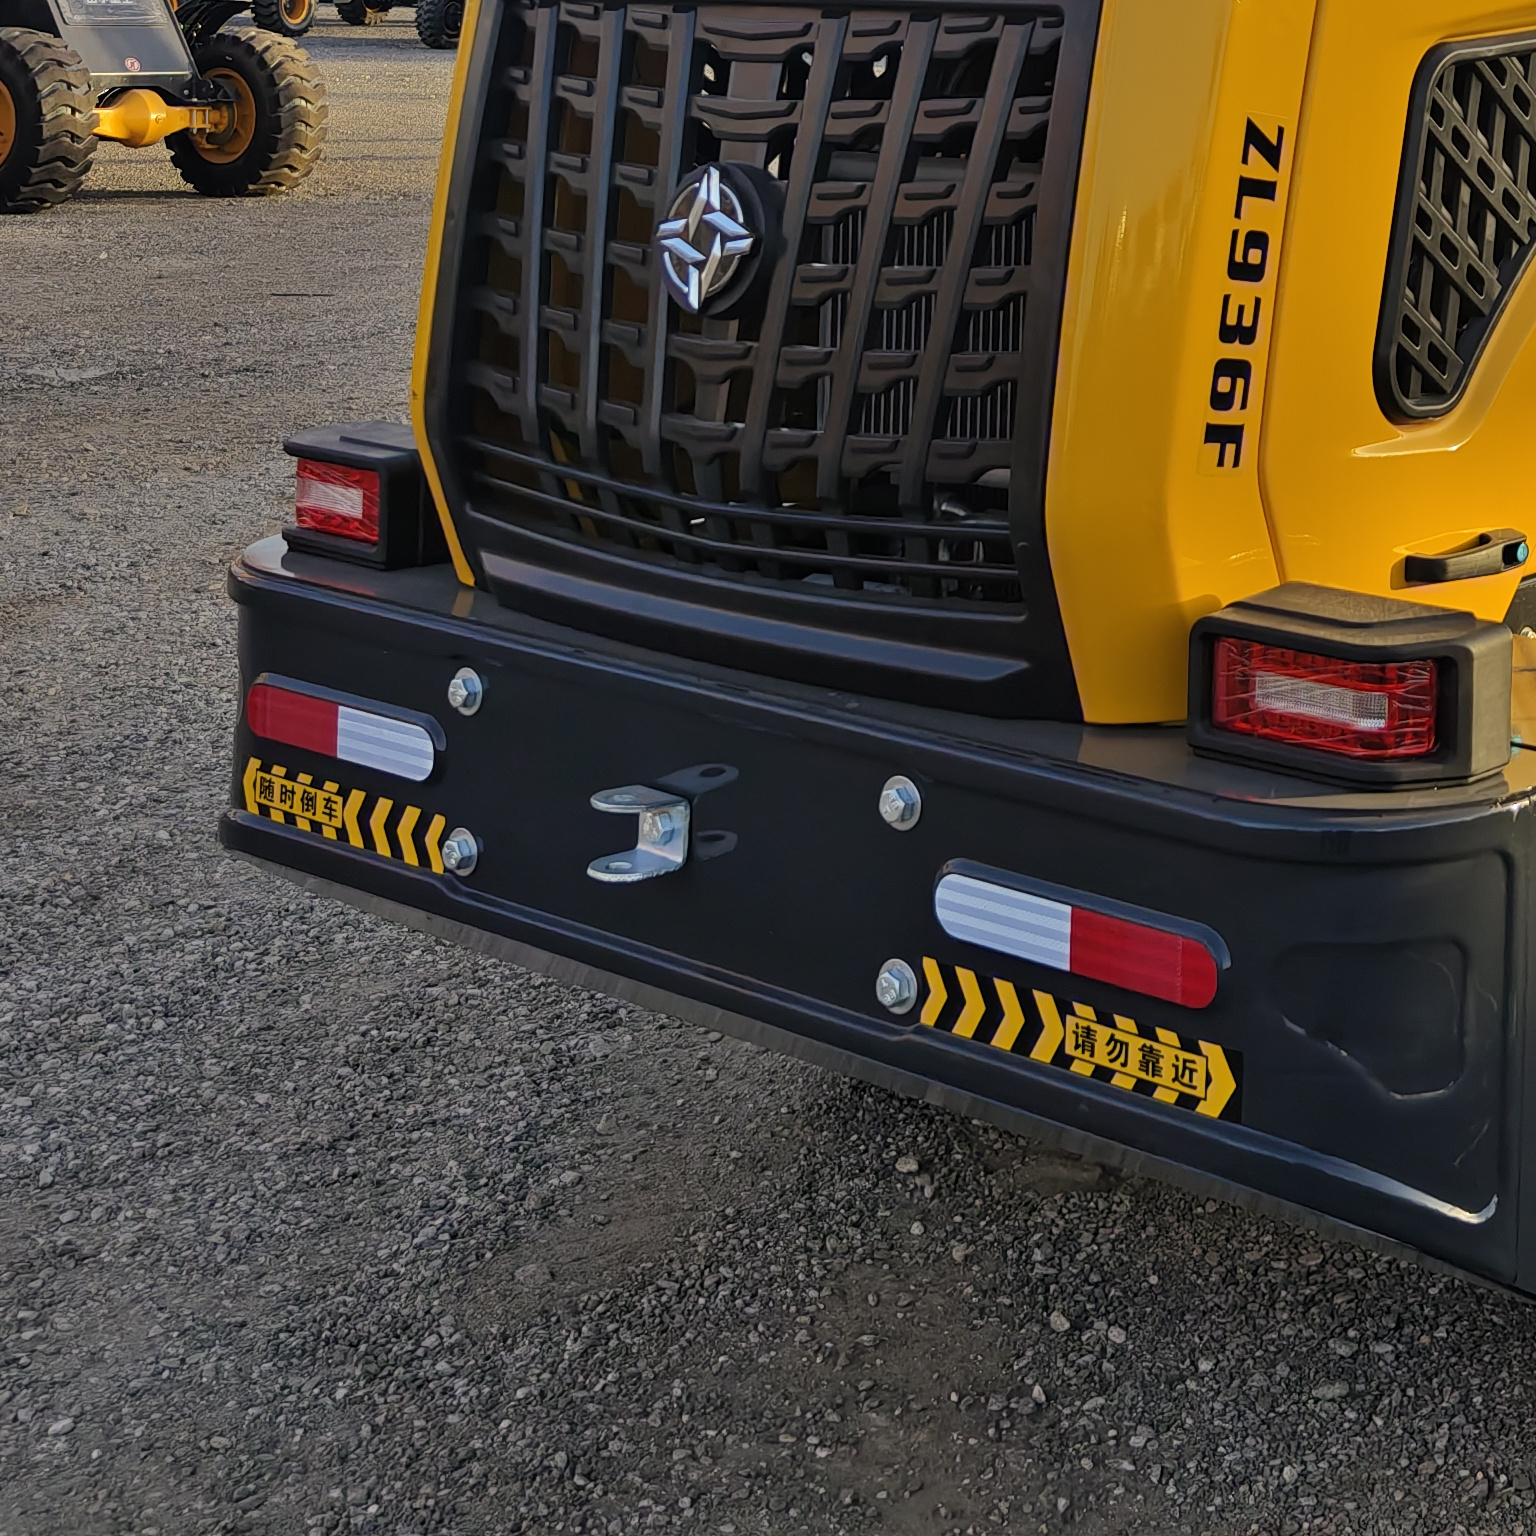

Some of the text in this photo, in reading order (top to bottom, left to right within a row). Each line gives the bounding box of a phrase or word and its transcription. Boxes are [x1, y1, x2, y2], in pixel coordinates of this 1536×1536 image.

[1203, 116, 1285, 470] ZL936F
[259, 776, 339, 823] 随时倒车
[1072, 1022, 1199, 1091] 请勿靠近
